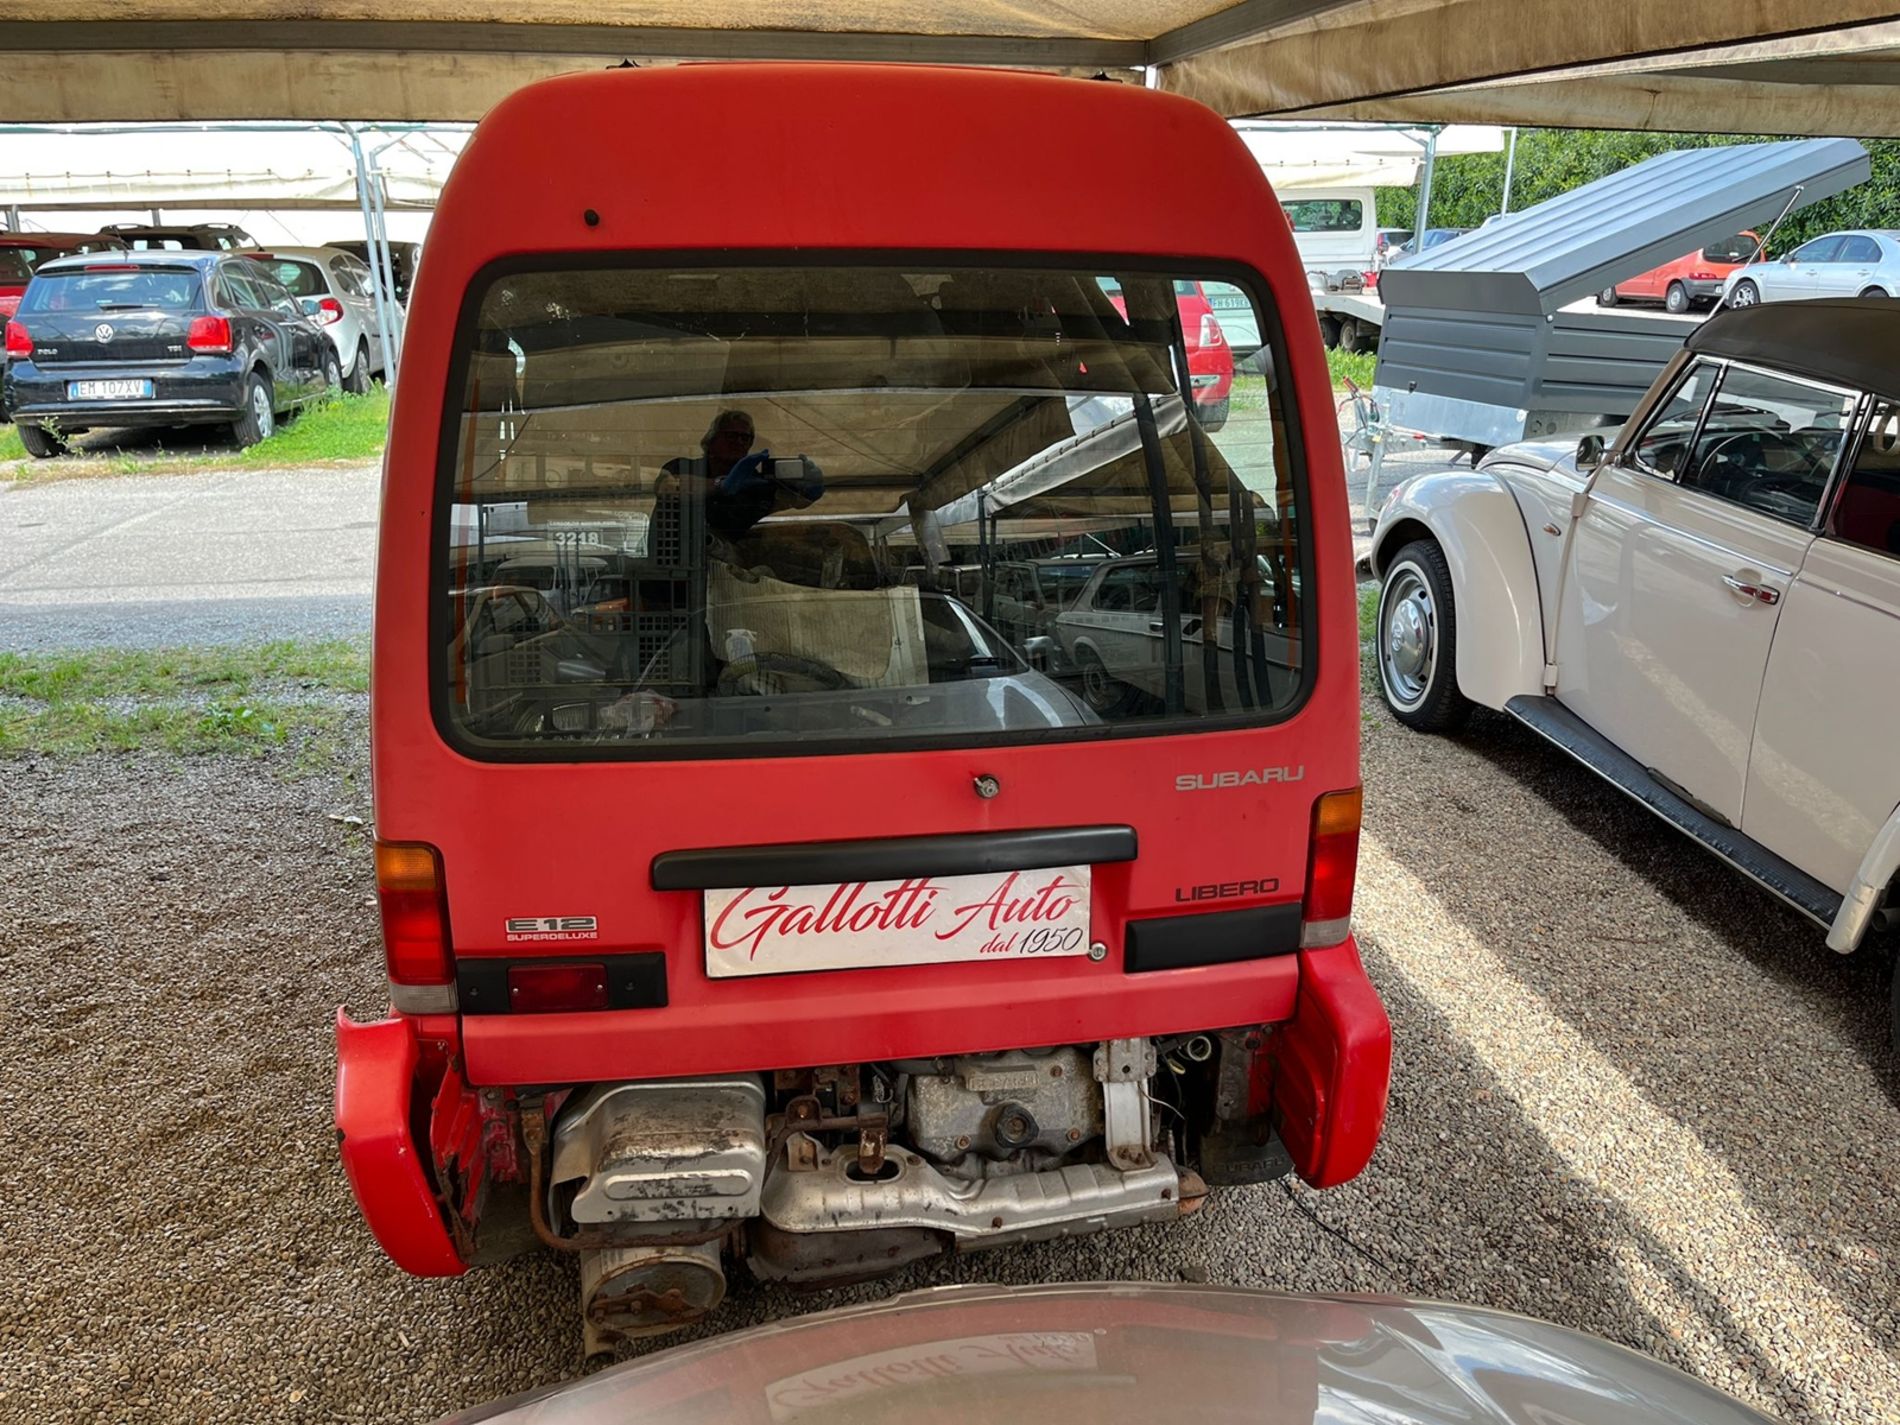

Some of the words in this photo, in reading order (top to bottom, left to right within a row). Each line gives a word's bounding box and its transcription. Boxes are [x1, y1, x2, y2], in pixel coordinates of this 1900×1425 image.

[80, 382, 96, 395] EM
[102, 381, 141, 395] 107XV
[1175, 765, 1305, 791] SUBARU
[1175, 878, 1280, 902] LIBERO
[508, 918, 595, 931] E12
[710, 876, 950, 961] Gallotti
[934, 871, 1086, 940] Auto
[507, 932, 598, 942] SUPERDELUXE
[979, 932, 1020, 954] dal
[1020, 927, 1084, 954] 1950
